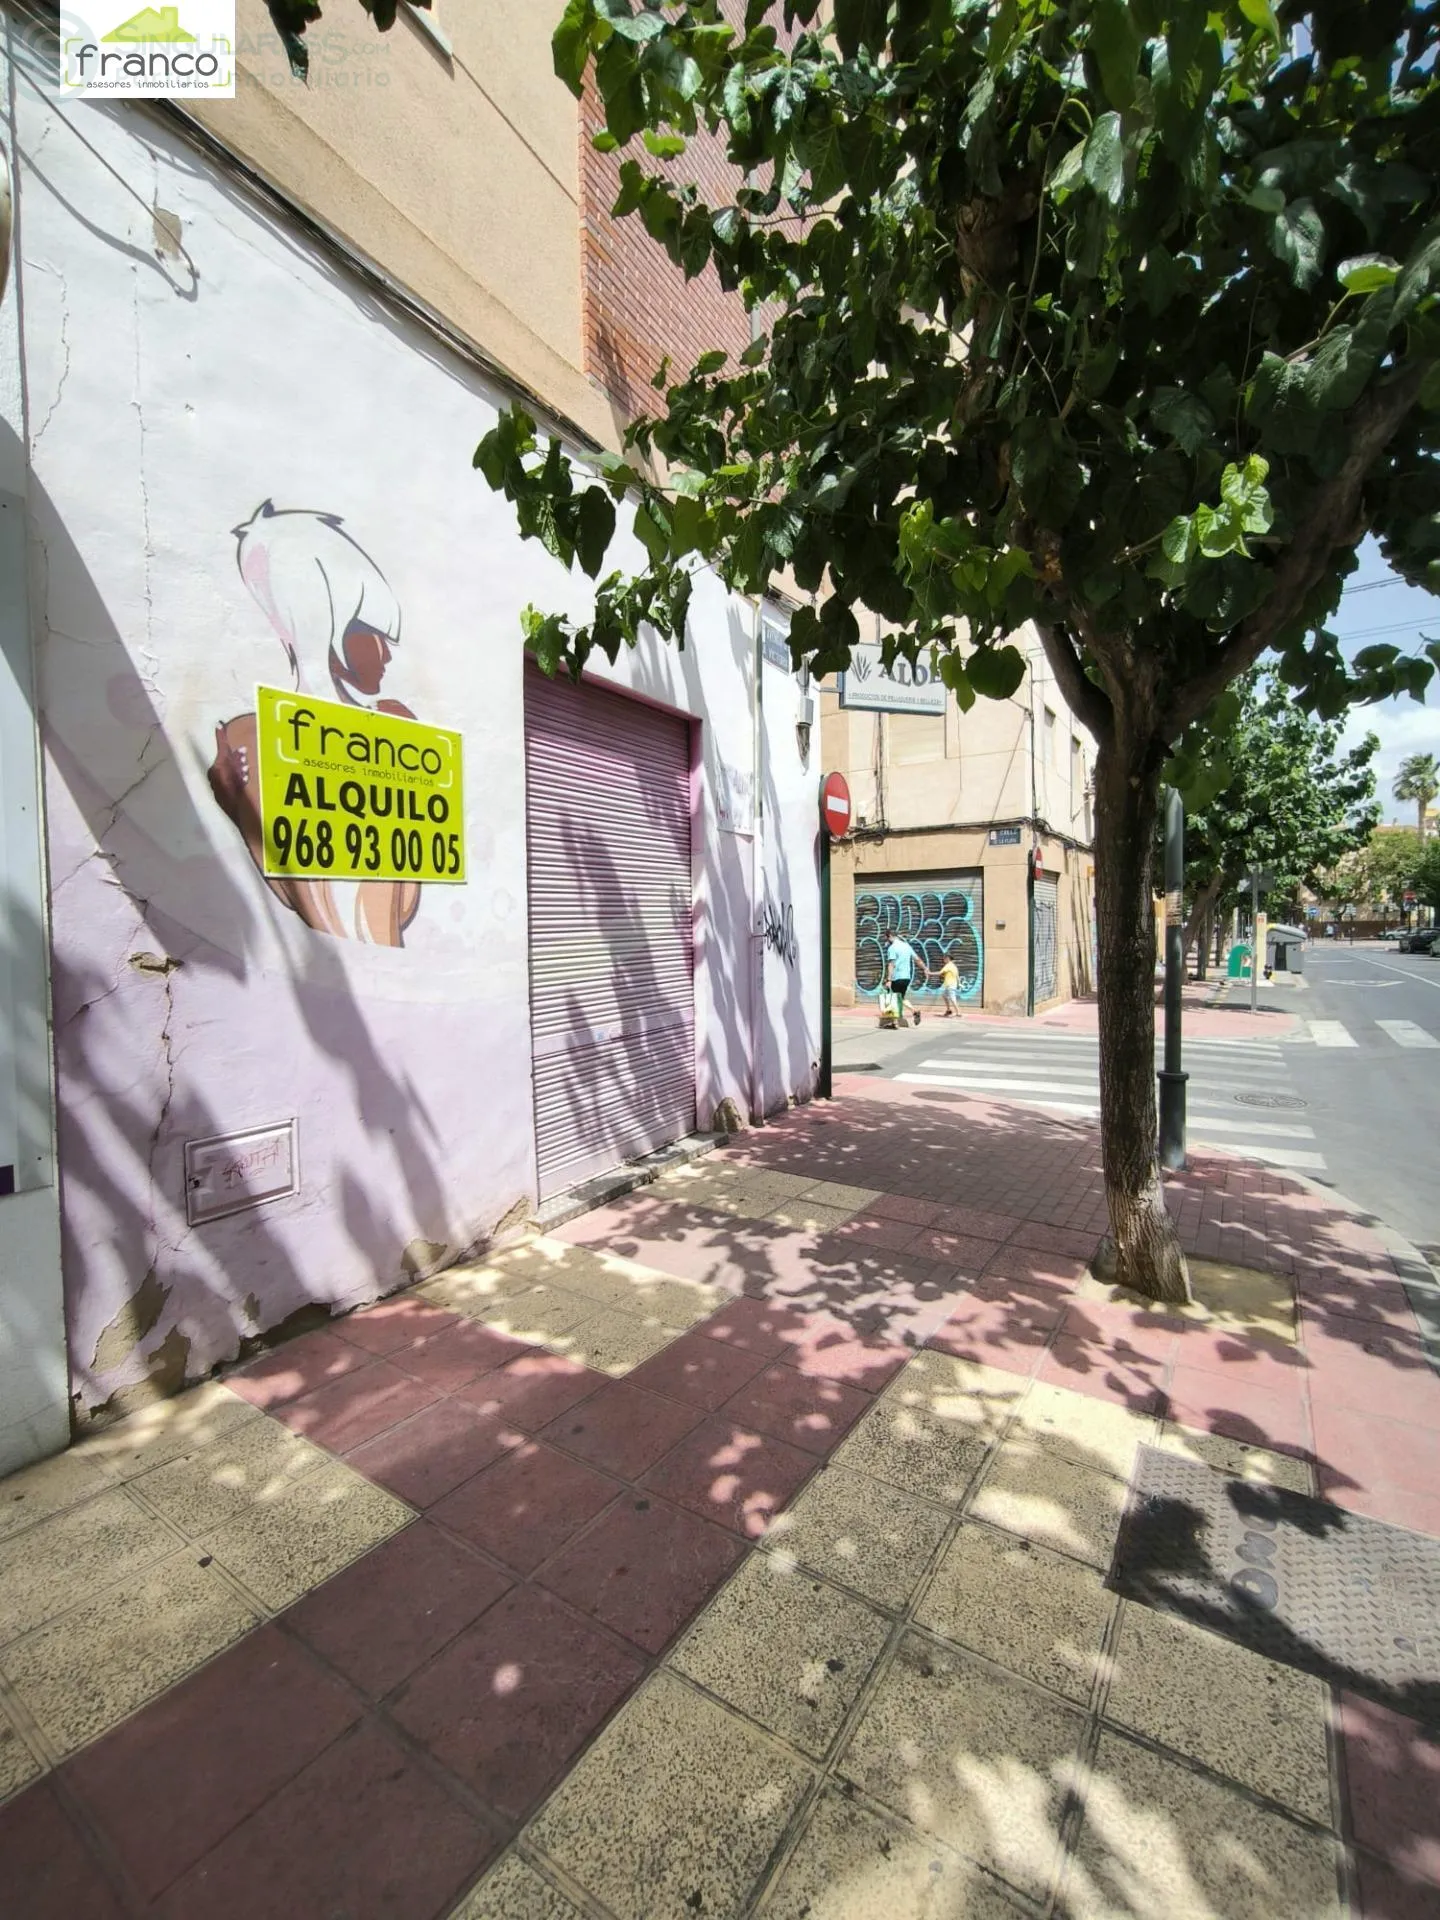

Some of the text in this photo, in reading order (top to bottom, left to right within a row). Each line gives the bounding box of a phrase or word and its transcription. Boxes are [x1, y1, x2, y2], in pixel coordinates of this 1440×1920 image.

[288, 708, 442, 775] franco
[284, 773, 449, 823] ALQUILO
[303, 758, 434, 787] asesores inmobiliarios
[273, 815, 460, 874] 968 93 00 05
